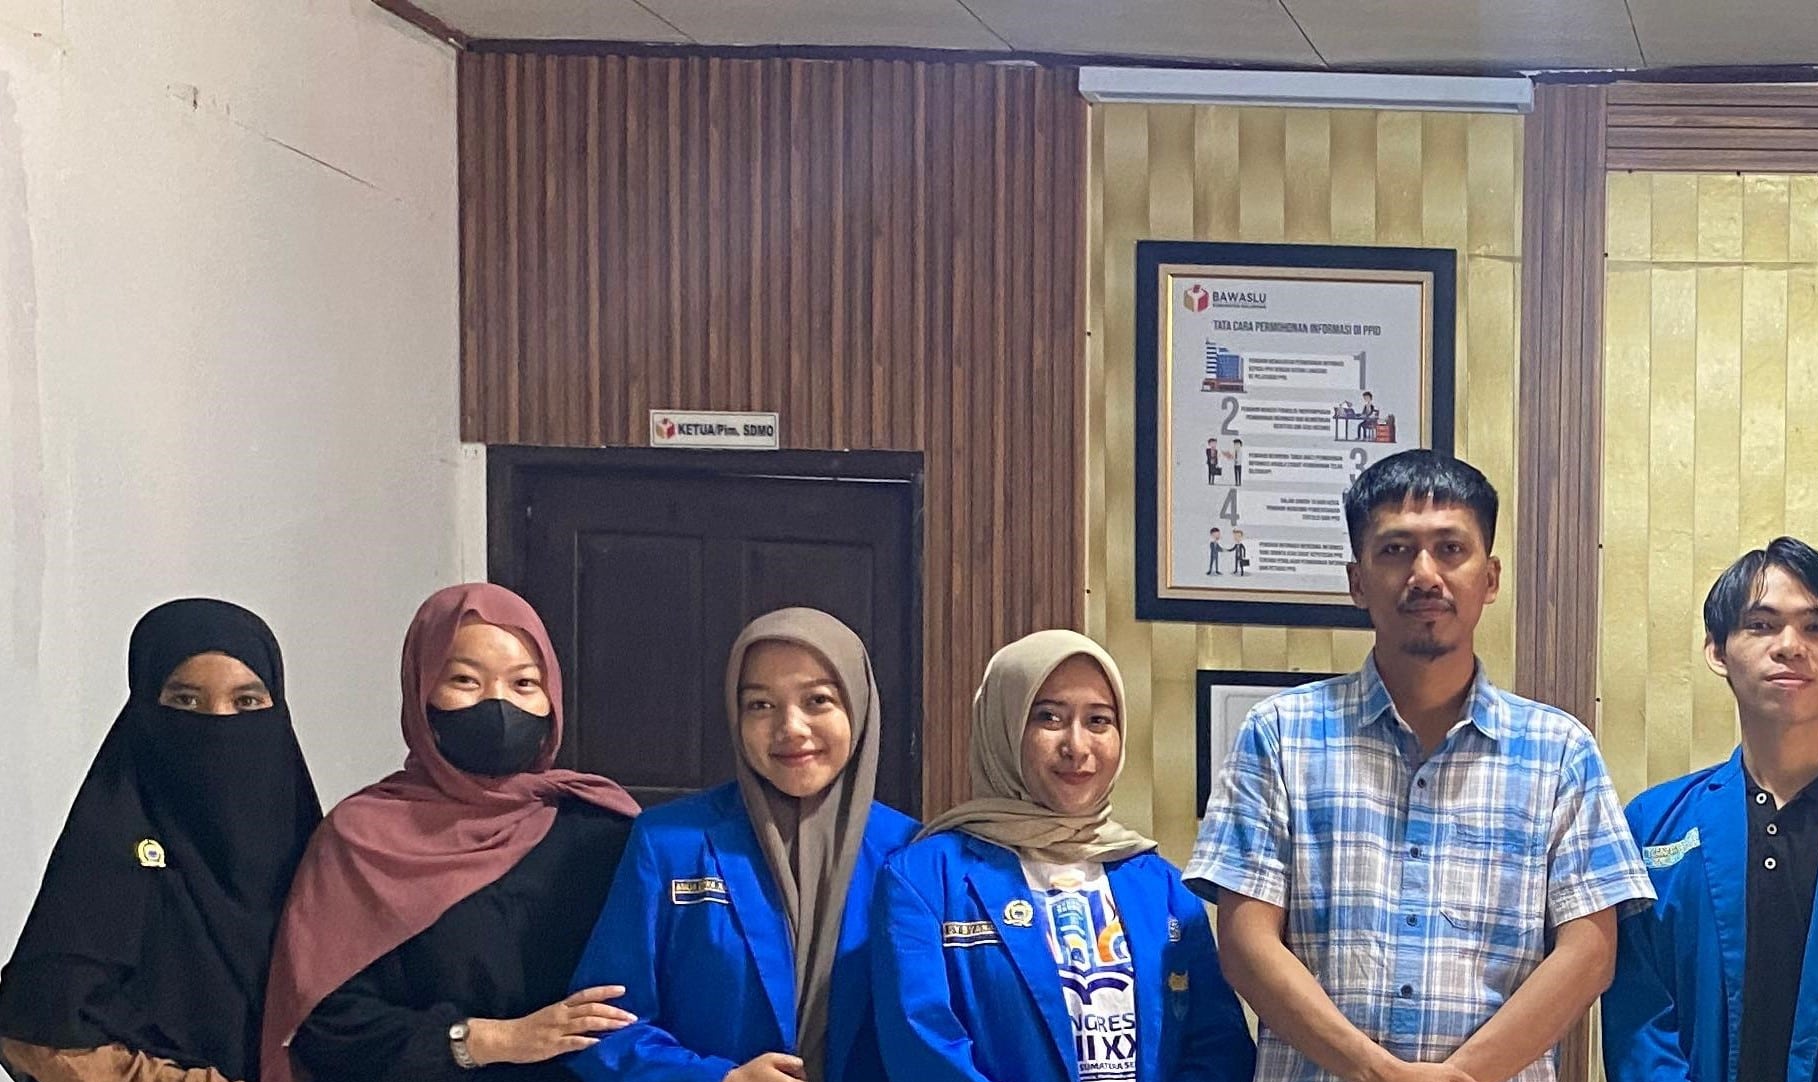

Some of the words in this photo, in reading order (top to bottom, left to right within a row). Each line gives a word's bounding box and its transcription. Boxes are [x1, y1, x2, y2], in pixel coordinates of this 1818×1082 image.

[1212, 291, 1267, 304] BAWASLU
[1213, 320, 1232, 331] TATA
[1353, 351, 1367, 390] 1
[743, 424, 774, 437] SDMO
[1221, 396, 1240, 436] 2
[1349, 447, 1369, 485] 3
[1219, 488, 1240, 527] 4
